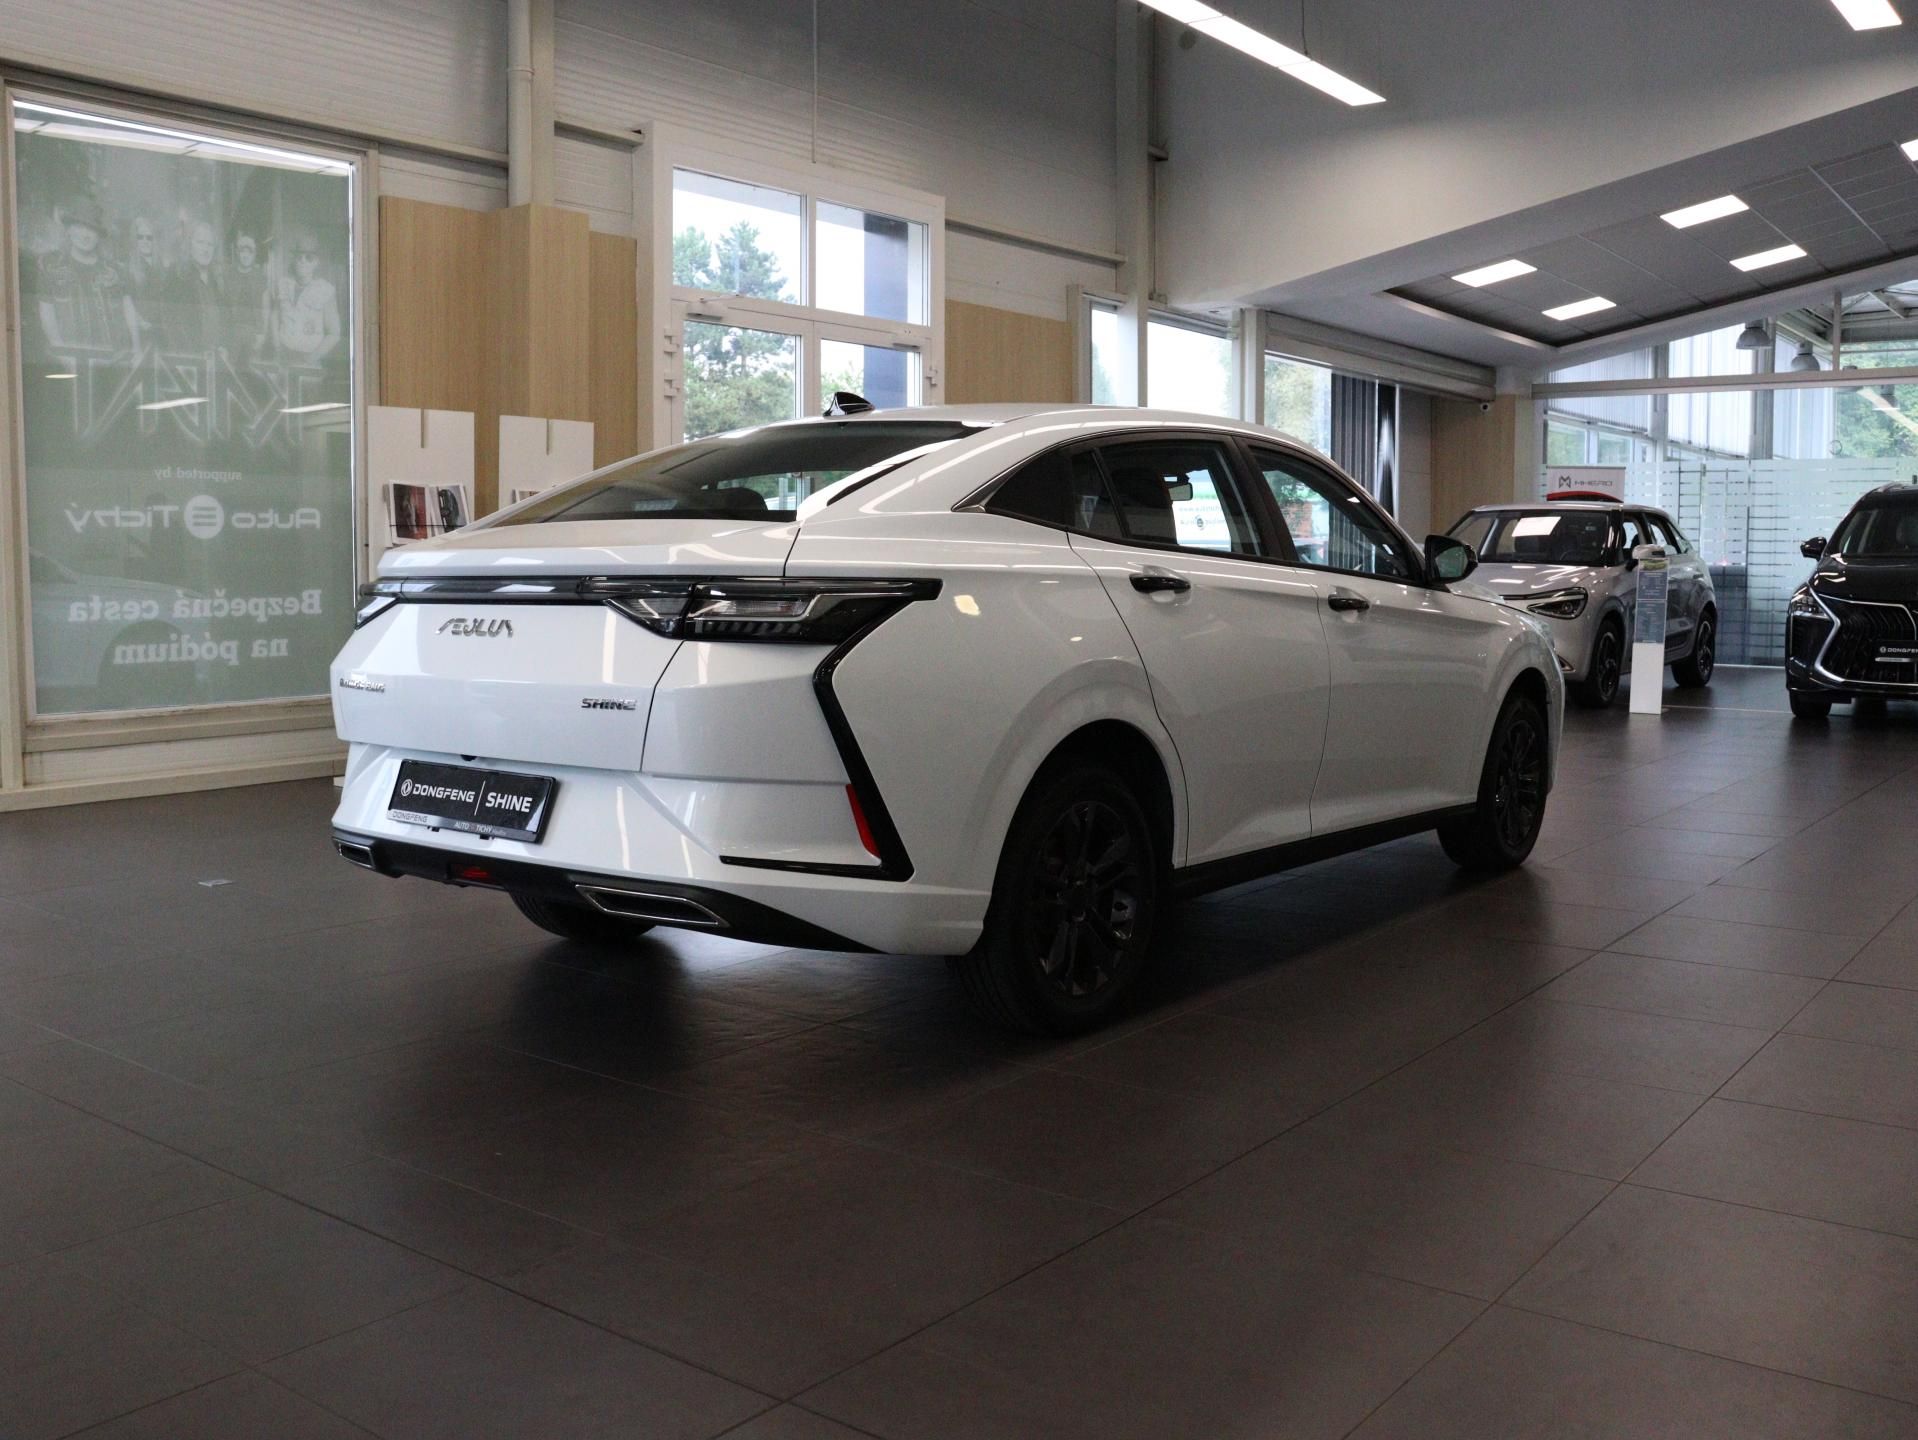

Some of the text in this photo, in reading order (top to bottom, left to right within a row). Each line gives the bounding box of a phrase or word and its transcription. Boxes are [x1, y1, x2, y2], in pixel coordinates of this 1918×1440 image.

[581, 698, 637, 711] SHINE
[412, 783, 533, 813] DONGFENG SHINE
